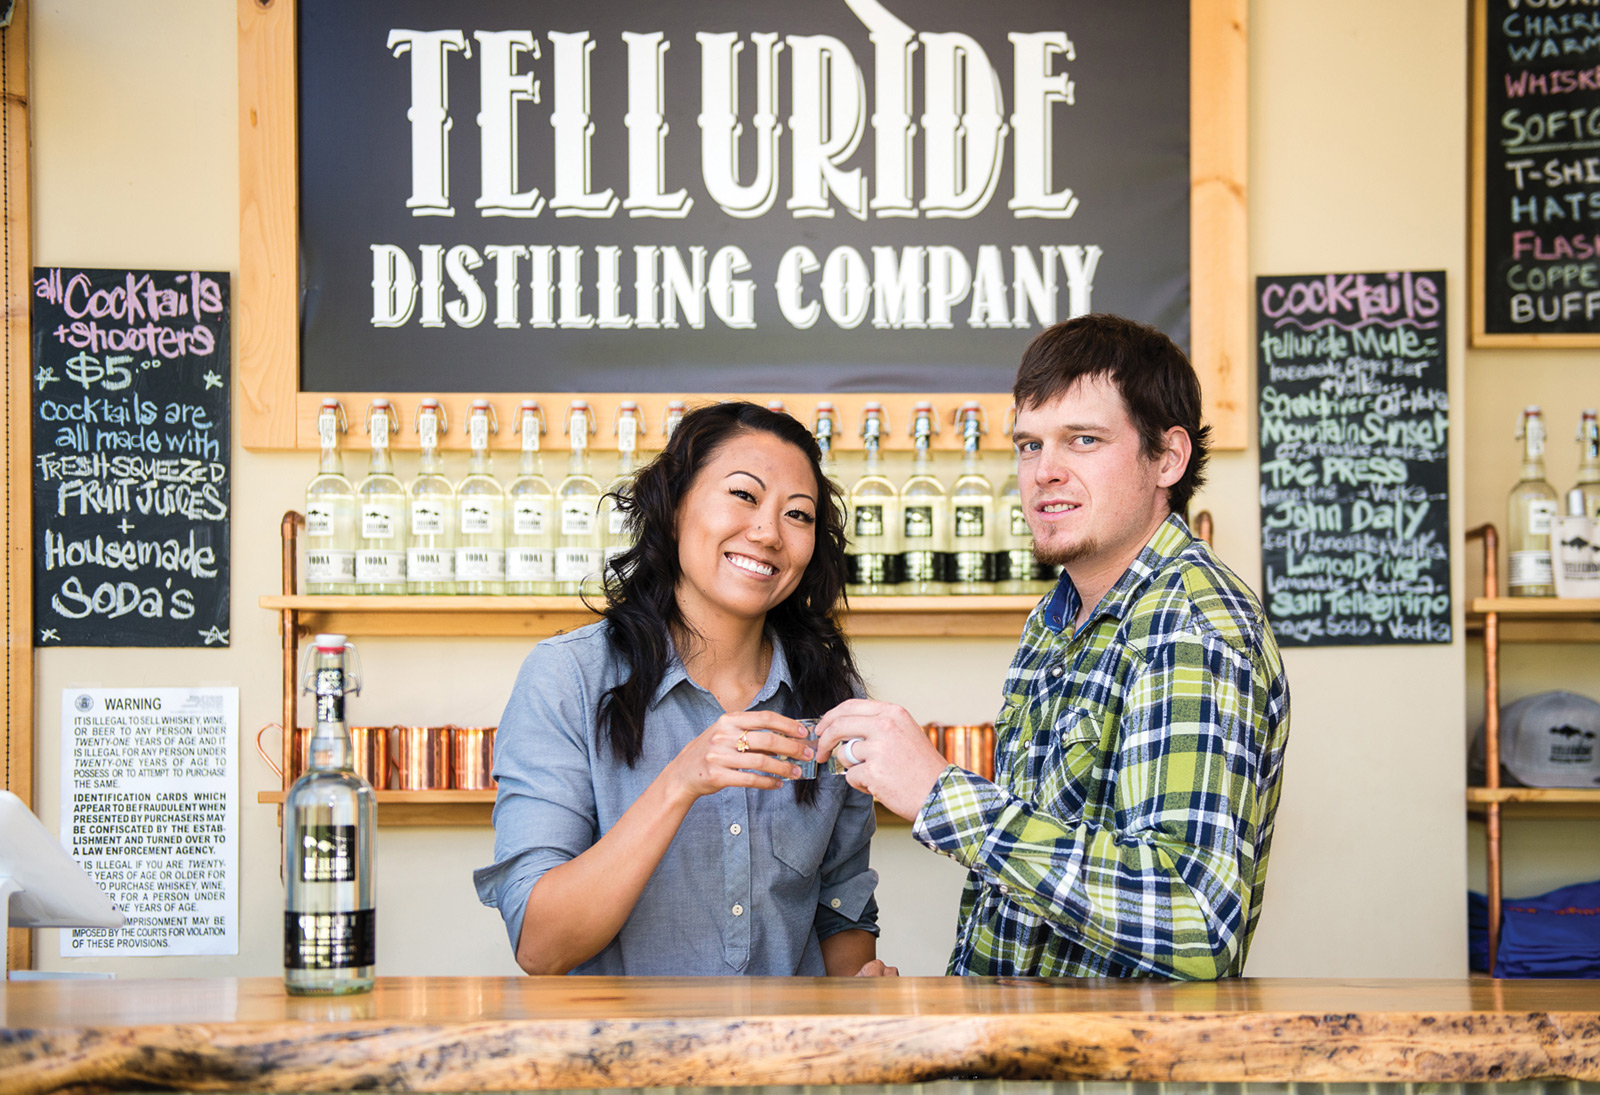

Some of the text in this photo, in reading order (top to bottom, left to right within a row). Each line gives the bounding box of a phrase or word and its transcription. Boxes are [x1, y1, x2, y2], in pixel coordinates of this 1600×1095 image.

[387, 26, 1079, 220] TELLURIDE
[370, 244, 1103, 329] DISTILLING COMPANY
[34, 268, 223, 325] all Cocktails
[40, 391, 213, 429] cocktails are
[55, 422, 220, 462] all made with
[1322, 457, 1409, 487] PRESS
[1265, 498, 1431, 541] John Daly
[44, 527, 219, 579] Housemade
[104, 698, 162, 710] WARNING
[74, 717, 82, 725] IT
[83, 717, 91, 725] IS
[92, 717, 127, 725] ILLEGAL
[129, 716, 139, 725] TO
[140, 716, 160, 725] SELL
[74, 727, 87, 736] OR
[92, 727, 115, 735] BEER
[120, 727, 131, 735] TO
[136, 727, 152, 735] ANY
[156, 727, 192, 735] PERSON
[75, 738, 130, 746] TWENTY-ONE
[135, 737, 162, 746] YEARS
[164, 737, 176, 745] OF
[178, 737, 197, 745] AGE
[74, 747, 227, 757] IS ILLEGAL FOR ANY PERSON UNDER
[75, 758, 227, 768] TWENTY-ONE YEARS OF AGE TO
[74, 768, 226, 778] POSSESS OR TO ATTEMPT TO PURCHASE
[74, 780, 91, 788] THE
[74, 793, 151, 802] IDENTIFICATION
[156, 793, 188, 801] CARDS
[74, 803, 226, 812] APPEAR TO BE FRAUDULENT WHEN
[73, 815, 129, 823] PRESENTED
[131, 814, 142, 822] BY
[145, 814, 205, 822] PURCHASERS
[73, 826, 86, 834] BE
[89, 825, 153, 833] CONFISCATED
[157, 825, 167, 833] BY
[172, 825, 189, 833] THE
[73, 835, 226, 845] LISHMENT AND TURNED OVER TO
[73, 847, 80, 855] A
[82, 847, 103, 855] LAW
[106, 847, 173, 855] ENFORCEMENT
[84, 861, 93, 869] IS
[96, 860, 133, 869] ILLEGAL
[136, 860, 143, 868] IF
[146, 860, 163, 869] YOU
[166, 860, 184, 868] ARE
[95, 871, 124, 880] YEARS
[127, 871, 138, 880] OF
[141, 871, 158, 880] AGE
[160, 871, 173, 880] OR
[175, 870, 205, 879] OLDER
[208, 870, 225, 879] FOR
[109, 882, 155, 890] PURCHASE
[121, 892, 138, 901] FOR
[143, 893, 149, 901] A
[153, 892, 190, 901] PERSON
[195, 892, 225, 900] UNDER
[134, 903, 162, 912] YEARS
[164, 903, 176, 912] OF
[192, 917, 210, 925] MAY
[214, 917, 225, 925] BE
[72, 927, 226, 937] IMPOSED BY THE COURTS FOR VIOLATION
[72, 939, 84, 948] OF
[87, 939, 115, 948] THESE
